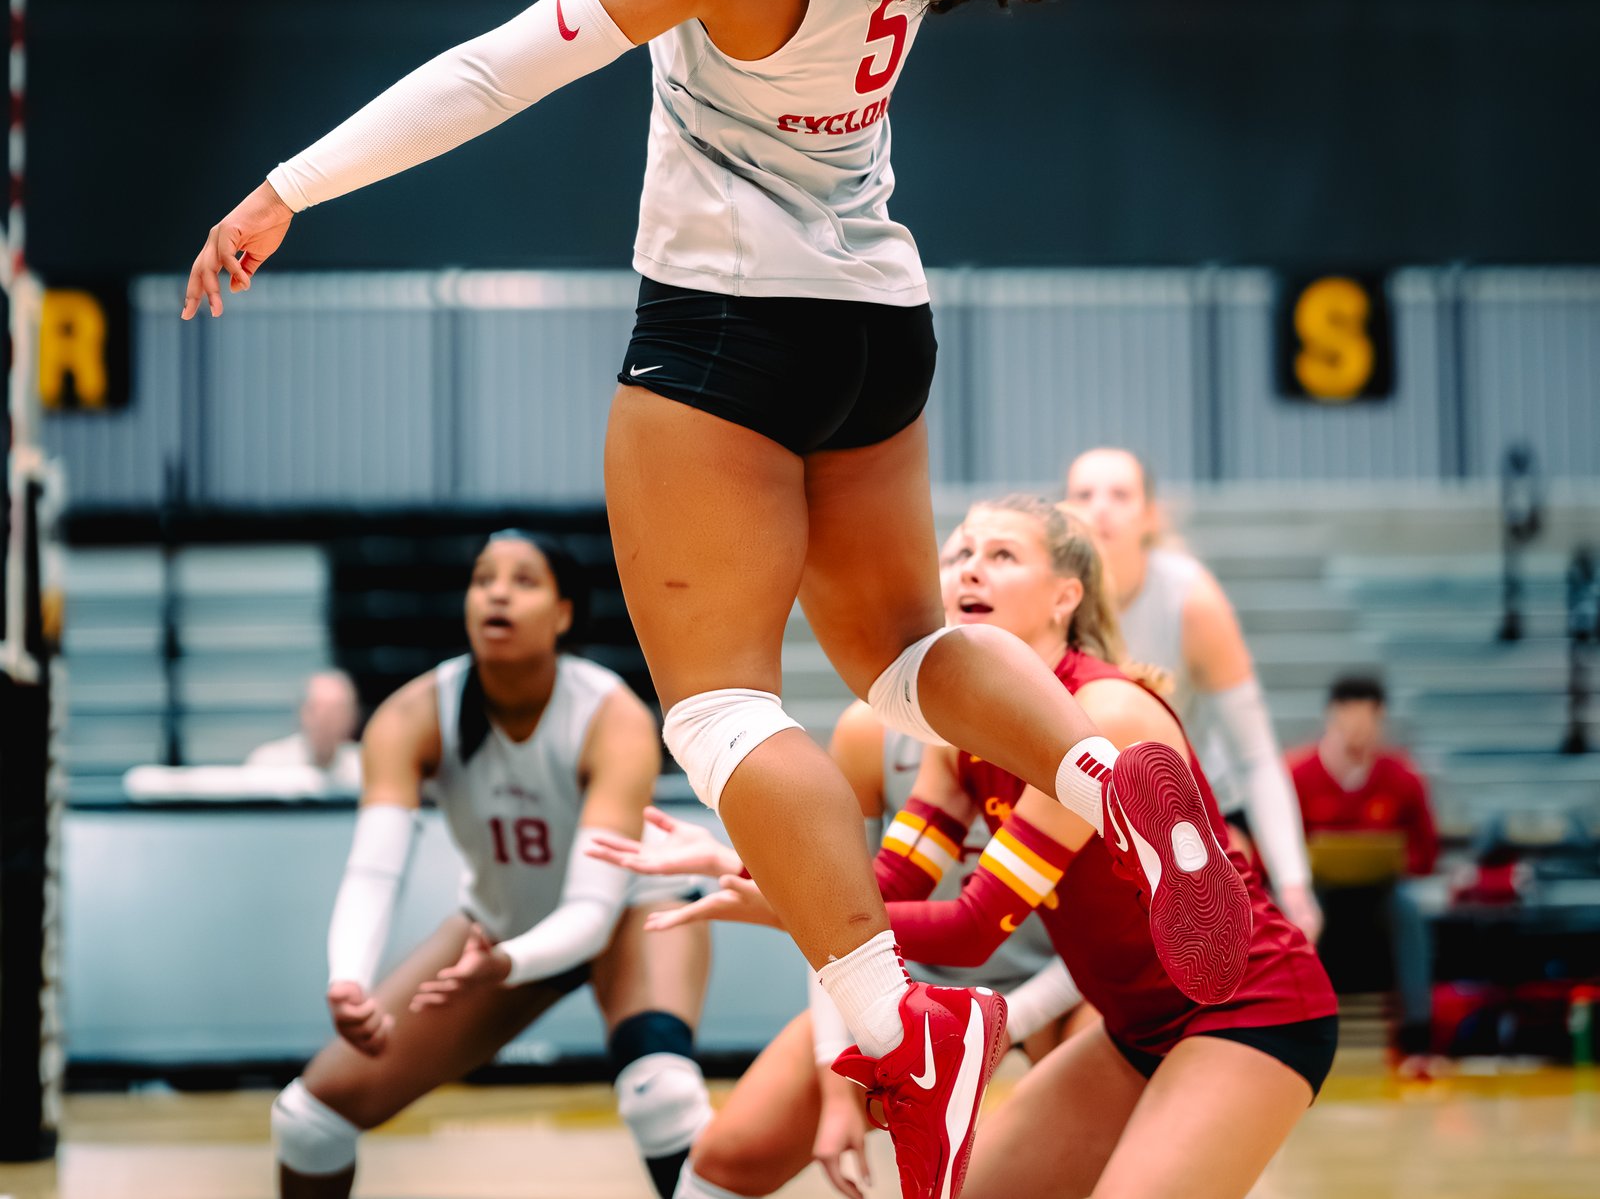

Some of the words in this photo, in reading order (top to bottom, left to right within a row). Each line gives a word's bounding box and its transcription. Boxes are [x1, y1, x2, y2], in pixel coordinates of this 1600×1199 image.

[40, 289, 106, 409] R
[1295, 278, 1373, 401] S
[489, 817, 553, 866] 18
